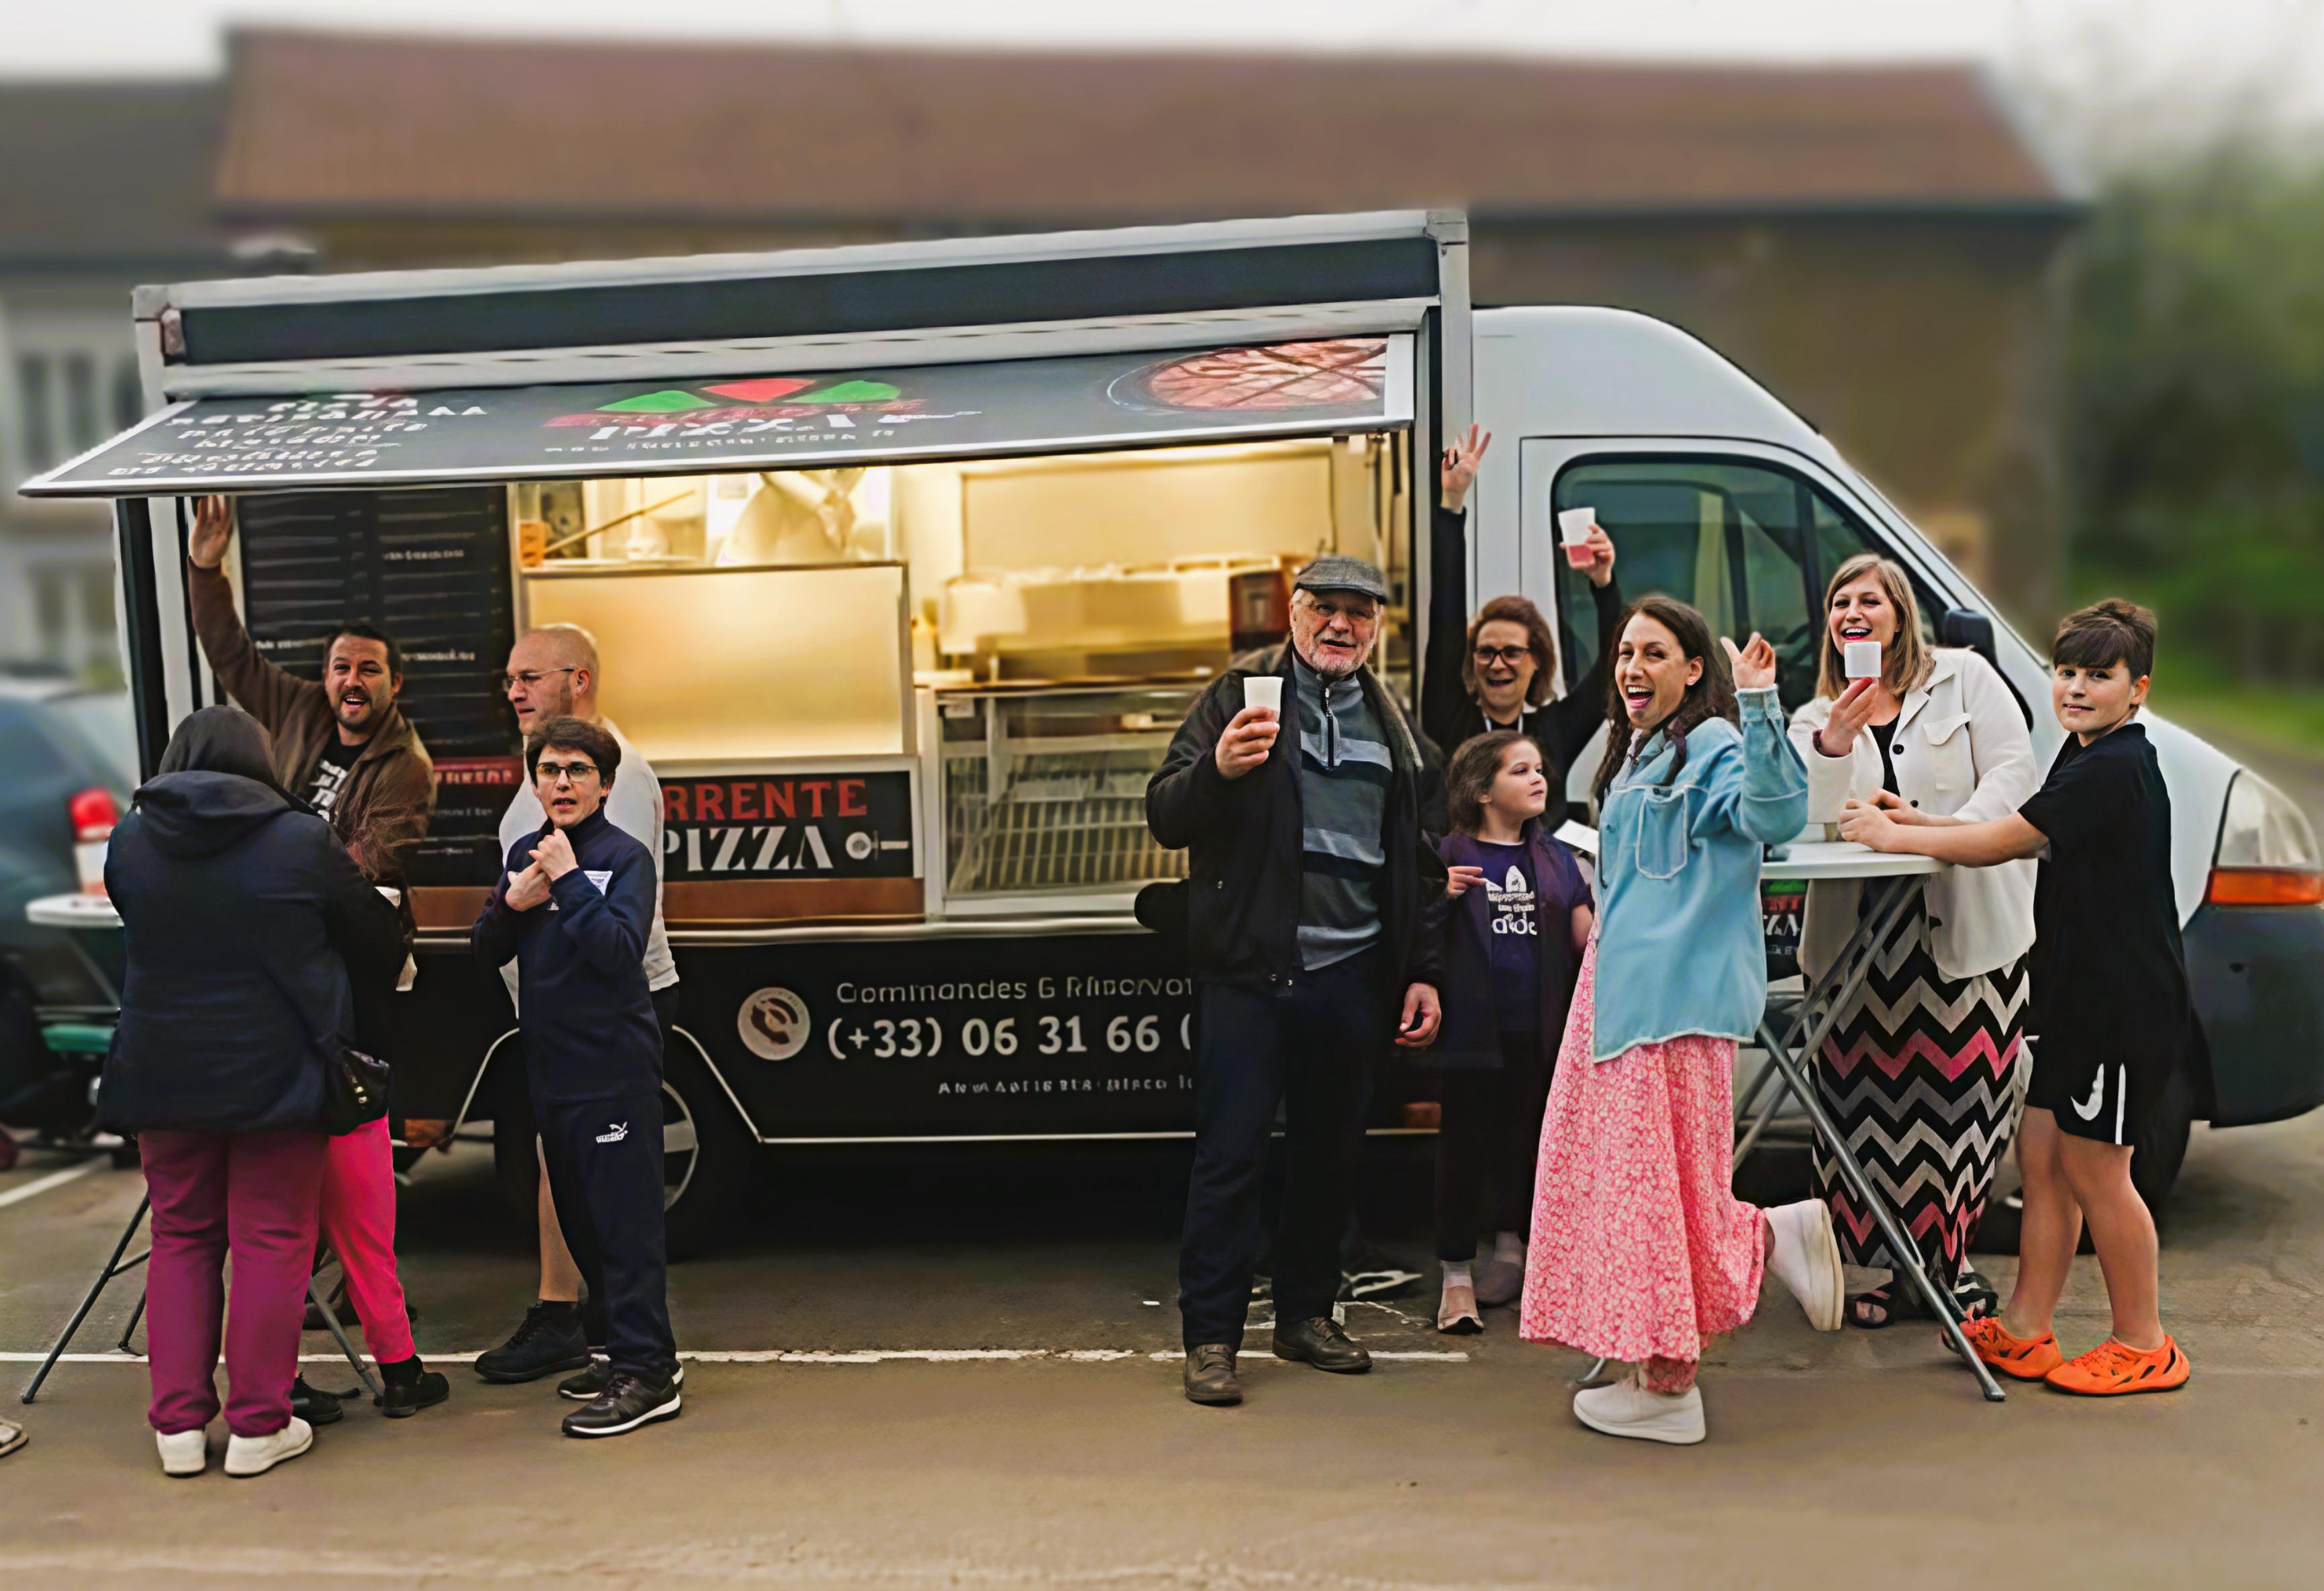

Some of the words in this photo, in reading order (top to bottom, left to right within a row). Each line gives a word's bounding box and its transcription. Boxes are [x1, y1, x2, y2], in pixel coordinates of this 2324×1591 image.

[828, 1016, 942, 1059] (+33)
[962, 1017, 1018, 1056] 06
[1038, 1016, 1087, 1054] 31
[1106, 1015, 1160, 1053] 66
